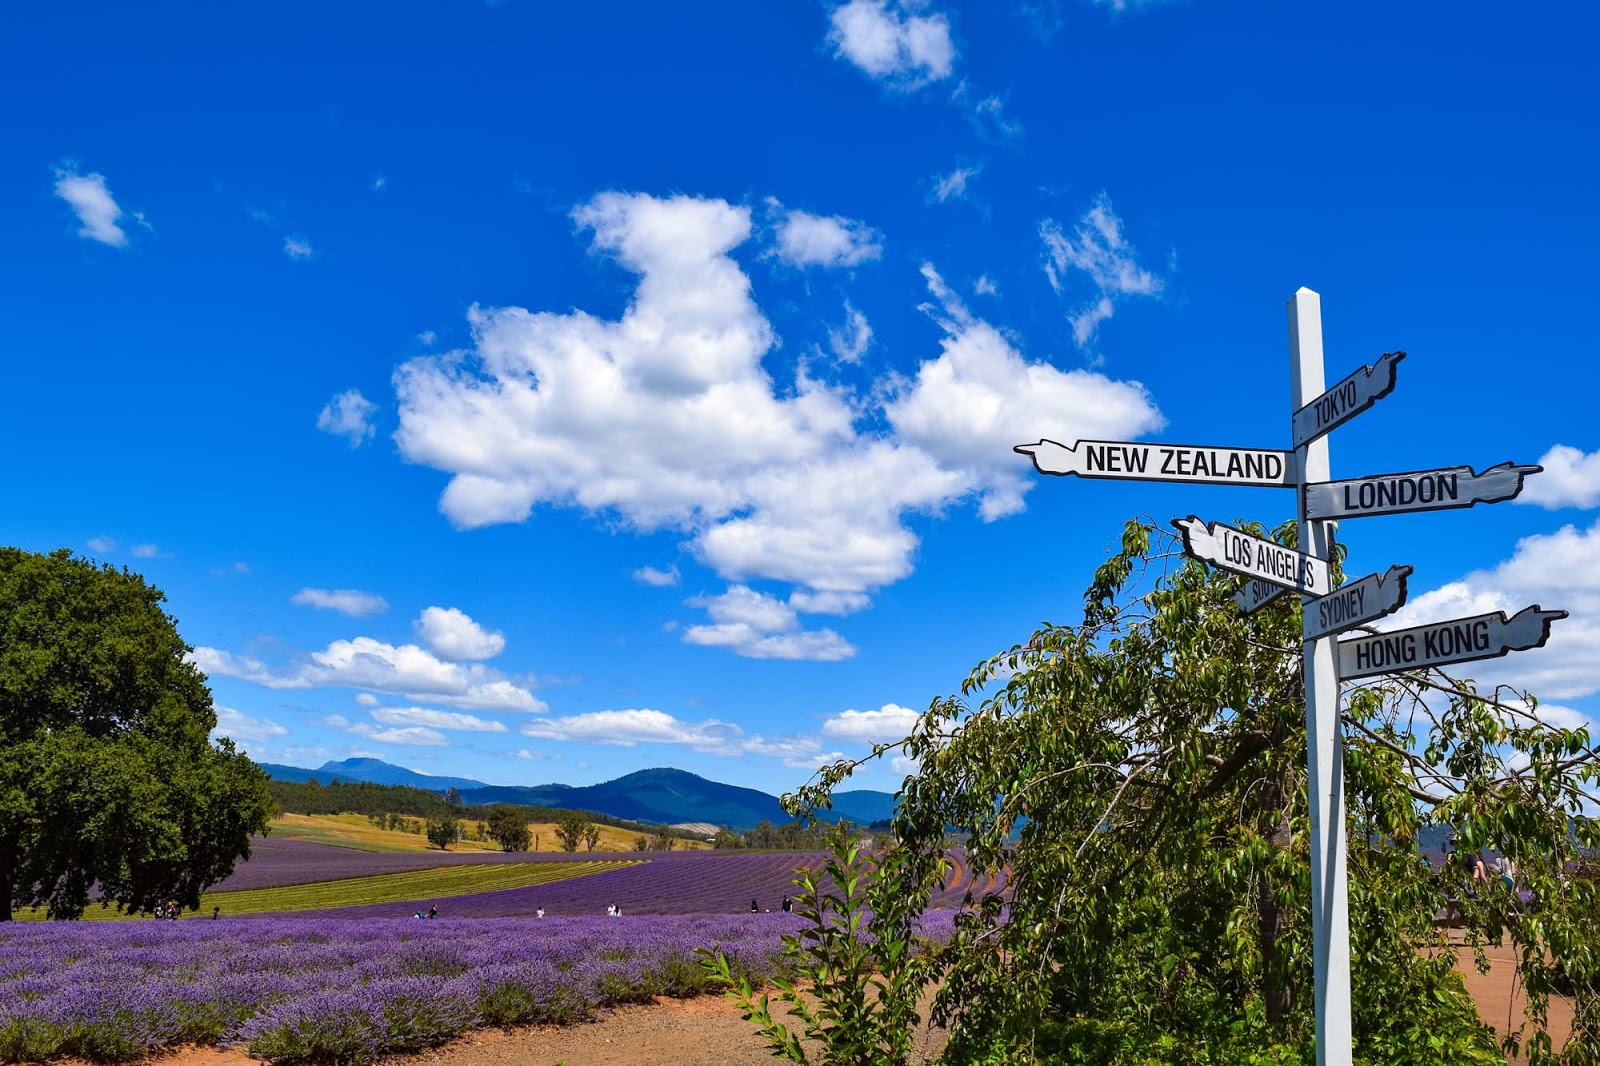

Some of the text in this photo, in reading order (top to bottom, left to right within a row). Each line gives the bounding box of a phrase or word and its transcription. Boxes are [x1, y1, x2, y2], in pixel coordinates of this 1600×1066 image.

[1315, 380, 1357, 428] TOKYO
[1086, 446, 1283, 480] NEW ZEALAND
[1345, 474, 1458, 511] LONDON
[1224, 531, 1314, 588] LOS ANGELES
[1319, 586, 1365, 628] SYDNEY
[1356, 624, 1490, 670] HONG KONG
